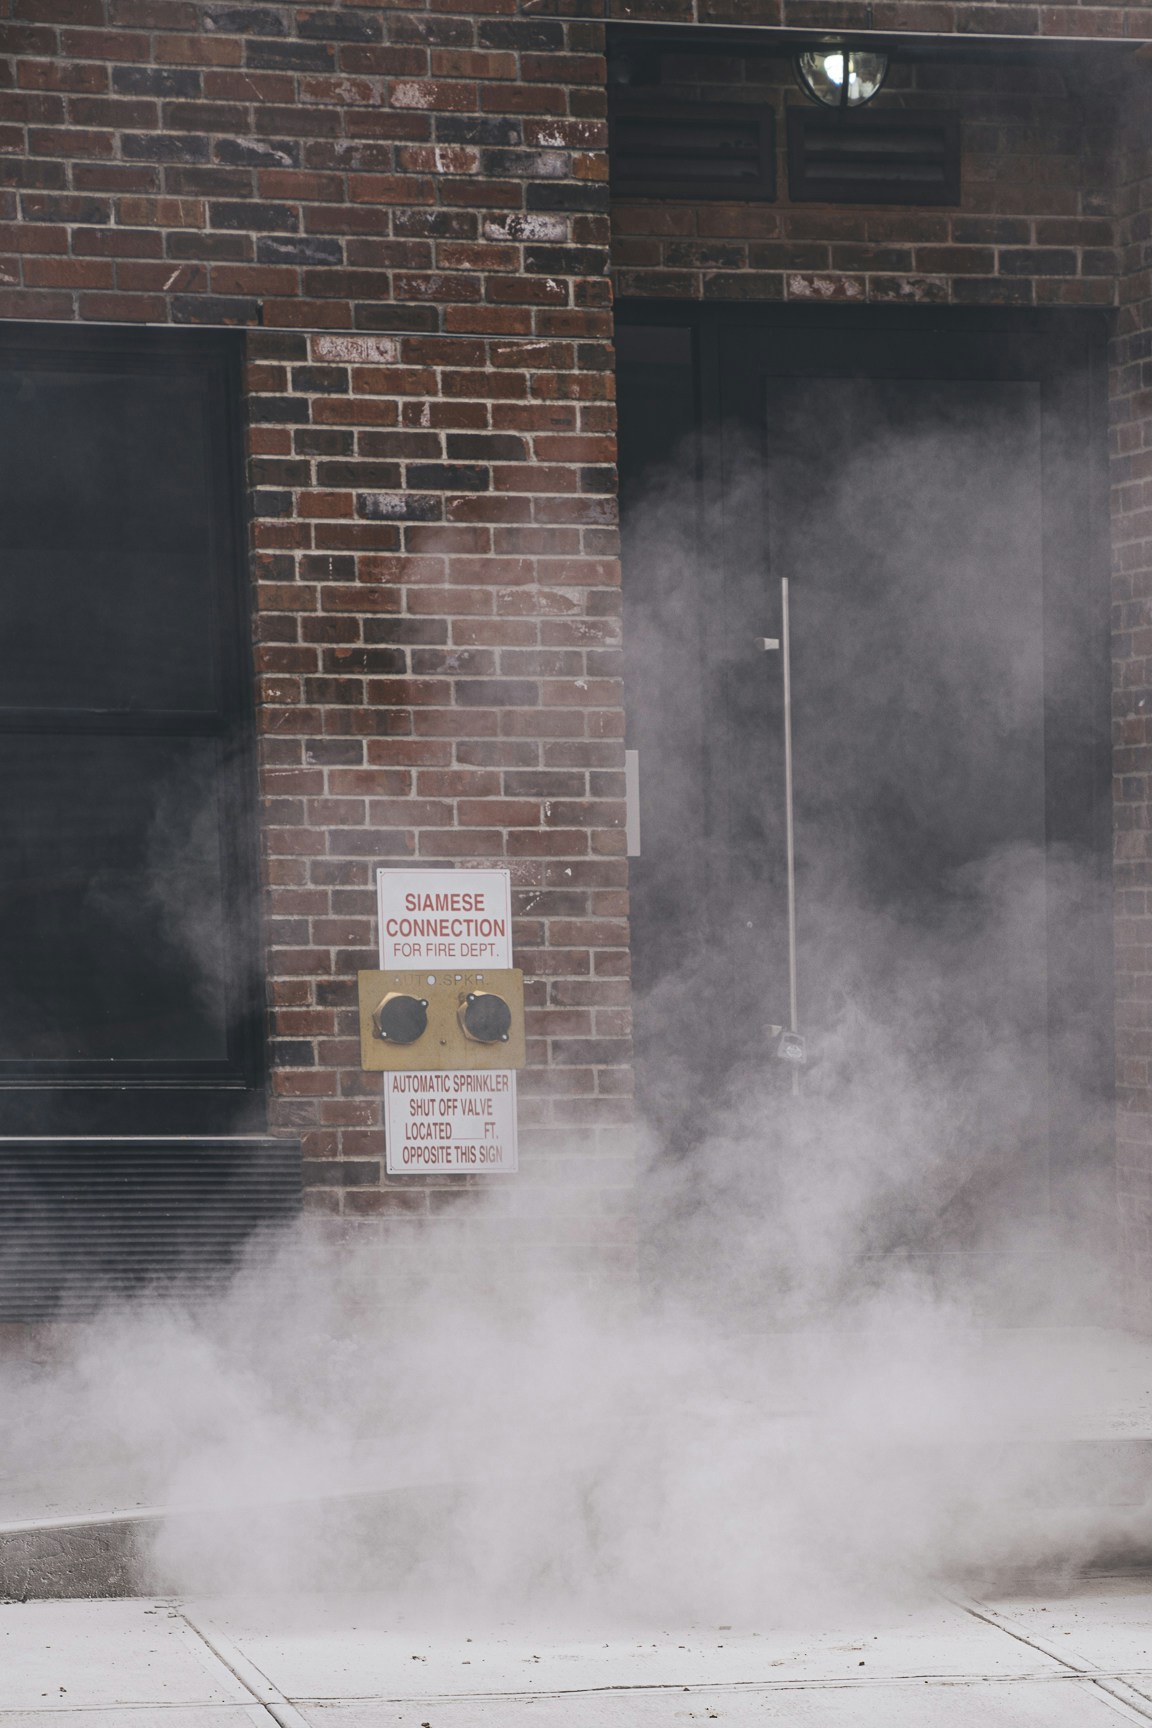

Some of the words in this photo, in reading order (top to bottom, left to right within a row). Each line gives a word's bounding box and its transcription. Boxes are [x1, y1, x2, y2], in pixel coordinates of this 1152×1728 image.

[405, 893, 485, 912] SIAMESE
[386, 918, 505, 937] CONNECTION
[393, 943, 422, 957] FOR
[426, 943, 456, 957] FIRE
[460, 943, 499, 957] DEPT.
[392, 1075, 450, 1093] AUTOMATIC
[453, 1074, 509, 1092] SPRINKLER
[409, 1098, 436, 1117] SHUT
[438, 1098, 458, 1117] OFF
[460, 1098, 493, 1116] VALVE
[405, 1122, 452, 1140] LOCATED
[484, 1121, 499, 1139] FT.
[402, 1145, 452, 1164] OPPOSITE
[454, 1145, 477, 1163] THIS
[479, 1145, 503, 1163] SIGN
